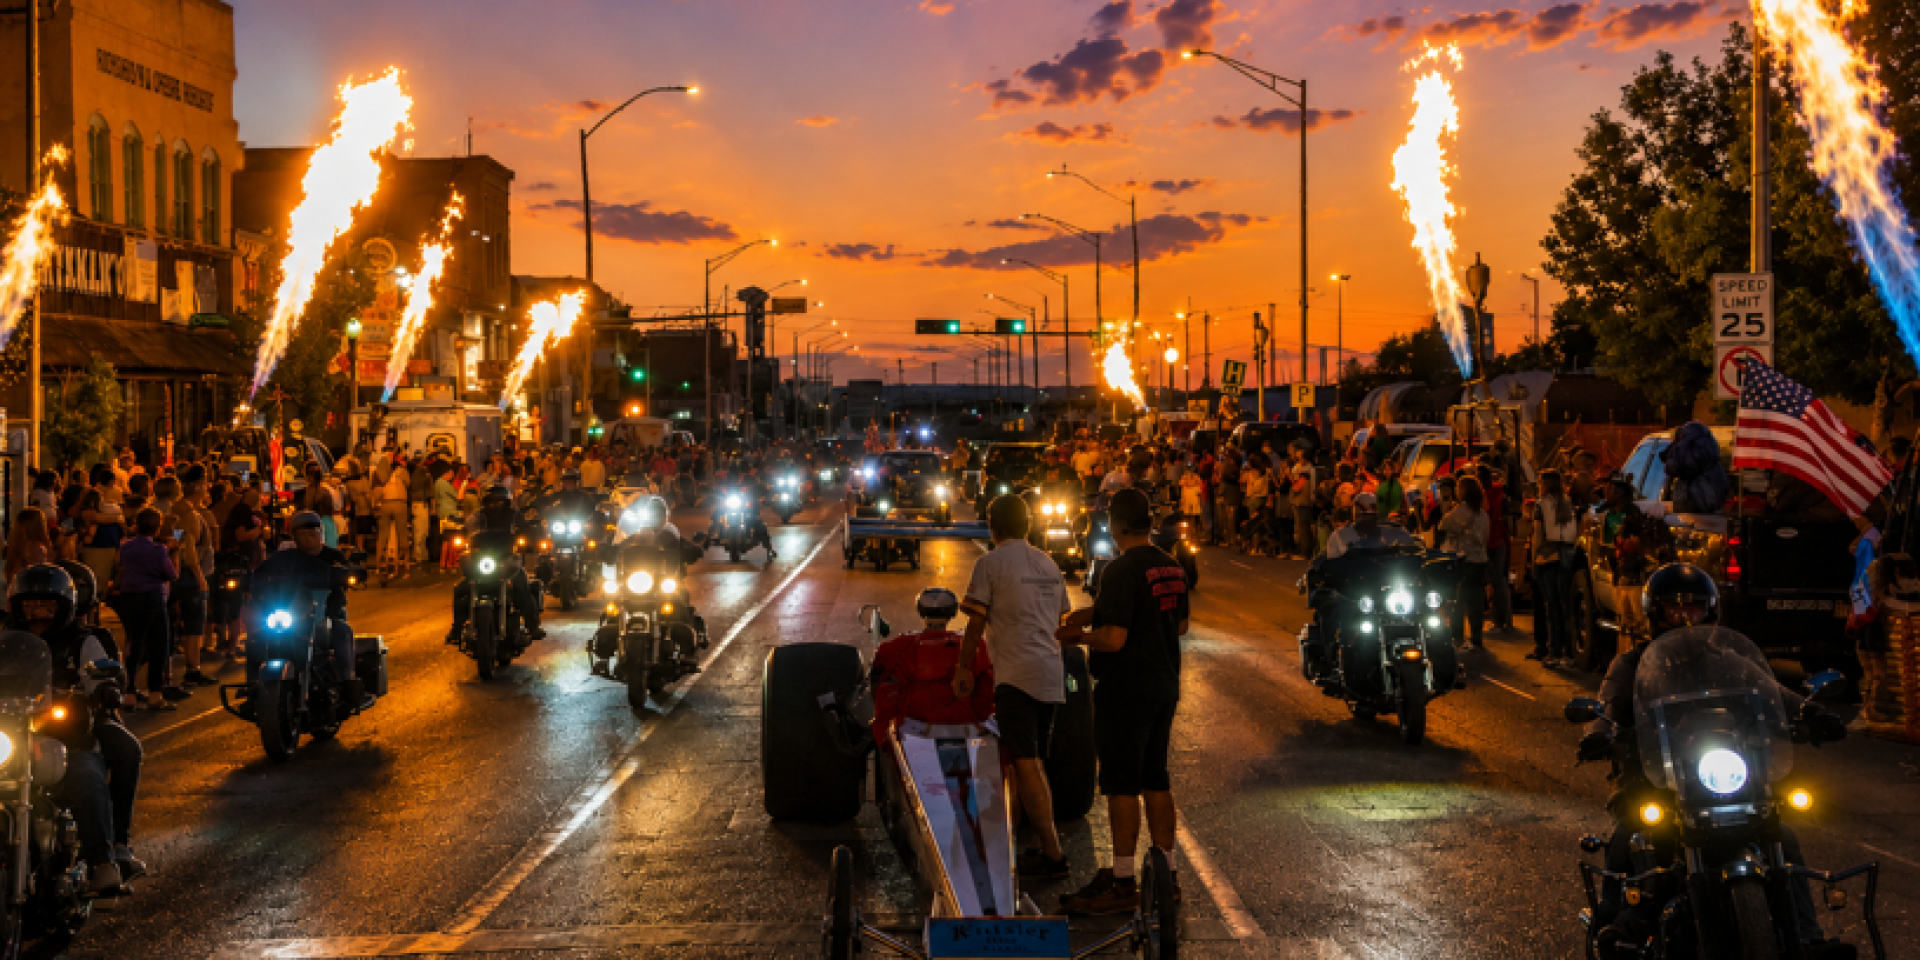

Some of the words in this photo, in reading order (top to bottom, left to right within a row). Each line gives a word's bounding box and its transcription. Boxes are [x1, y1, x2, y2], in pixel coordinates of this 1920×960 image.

[1717, 279, 1767, 292] SPEED
[1722, 296, 1760, 308] LIMIT
[1720, 313, 1766, 337] 25
[1298, 386, 1309, 402] P
